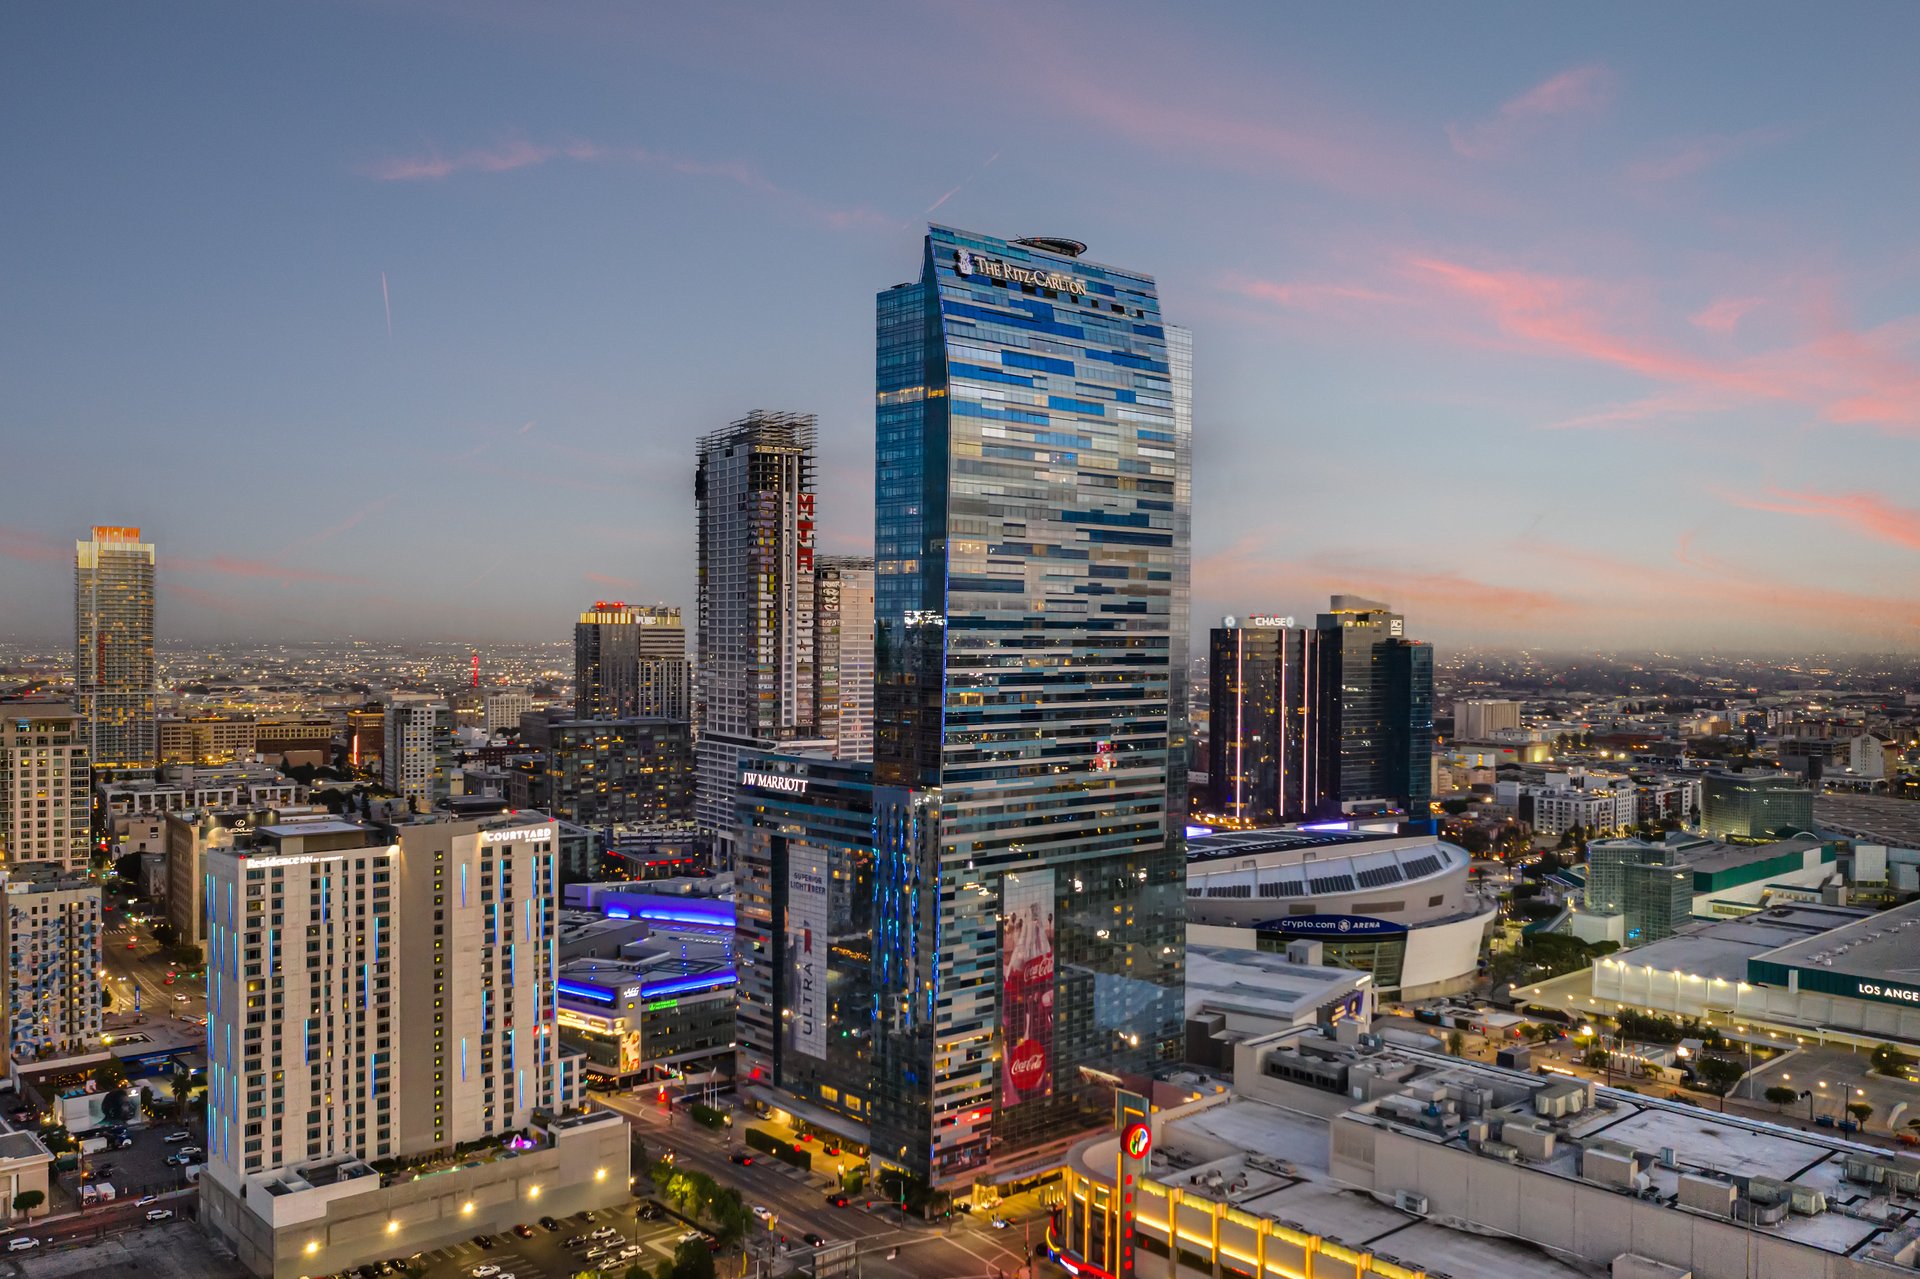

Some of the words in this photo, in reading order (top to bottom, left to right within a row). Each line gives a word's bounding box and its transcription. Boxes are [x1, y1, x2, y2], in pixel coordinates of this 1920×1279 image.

[974, 256, 1001, 276] THE
[1003, 263, 1087, 296] RITZ-CARLTON
[1255, 617, 1286, 627] CHASE
[742, 772, 757, 785] JW
[758, 774, 808, 792] MARRIOTT
[487, 828, 551, 842] COURTYARD
[246, 856, 300, 868] Residence
[793, 872, 822, 884] SUPERIOR
[790, 881, 806, 891] LIGHT
[1282, 920, 1336, 929] crypto.com
[803, 962, 813, 1036] ULTRA
[1859, 983, 1881, 996] LOS
[1884, 988, 1919, 1001] ANGE
[1011, 1054, 1044, 1075] Coca-Cola
